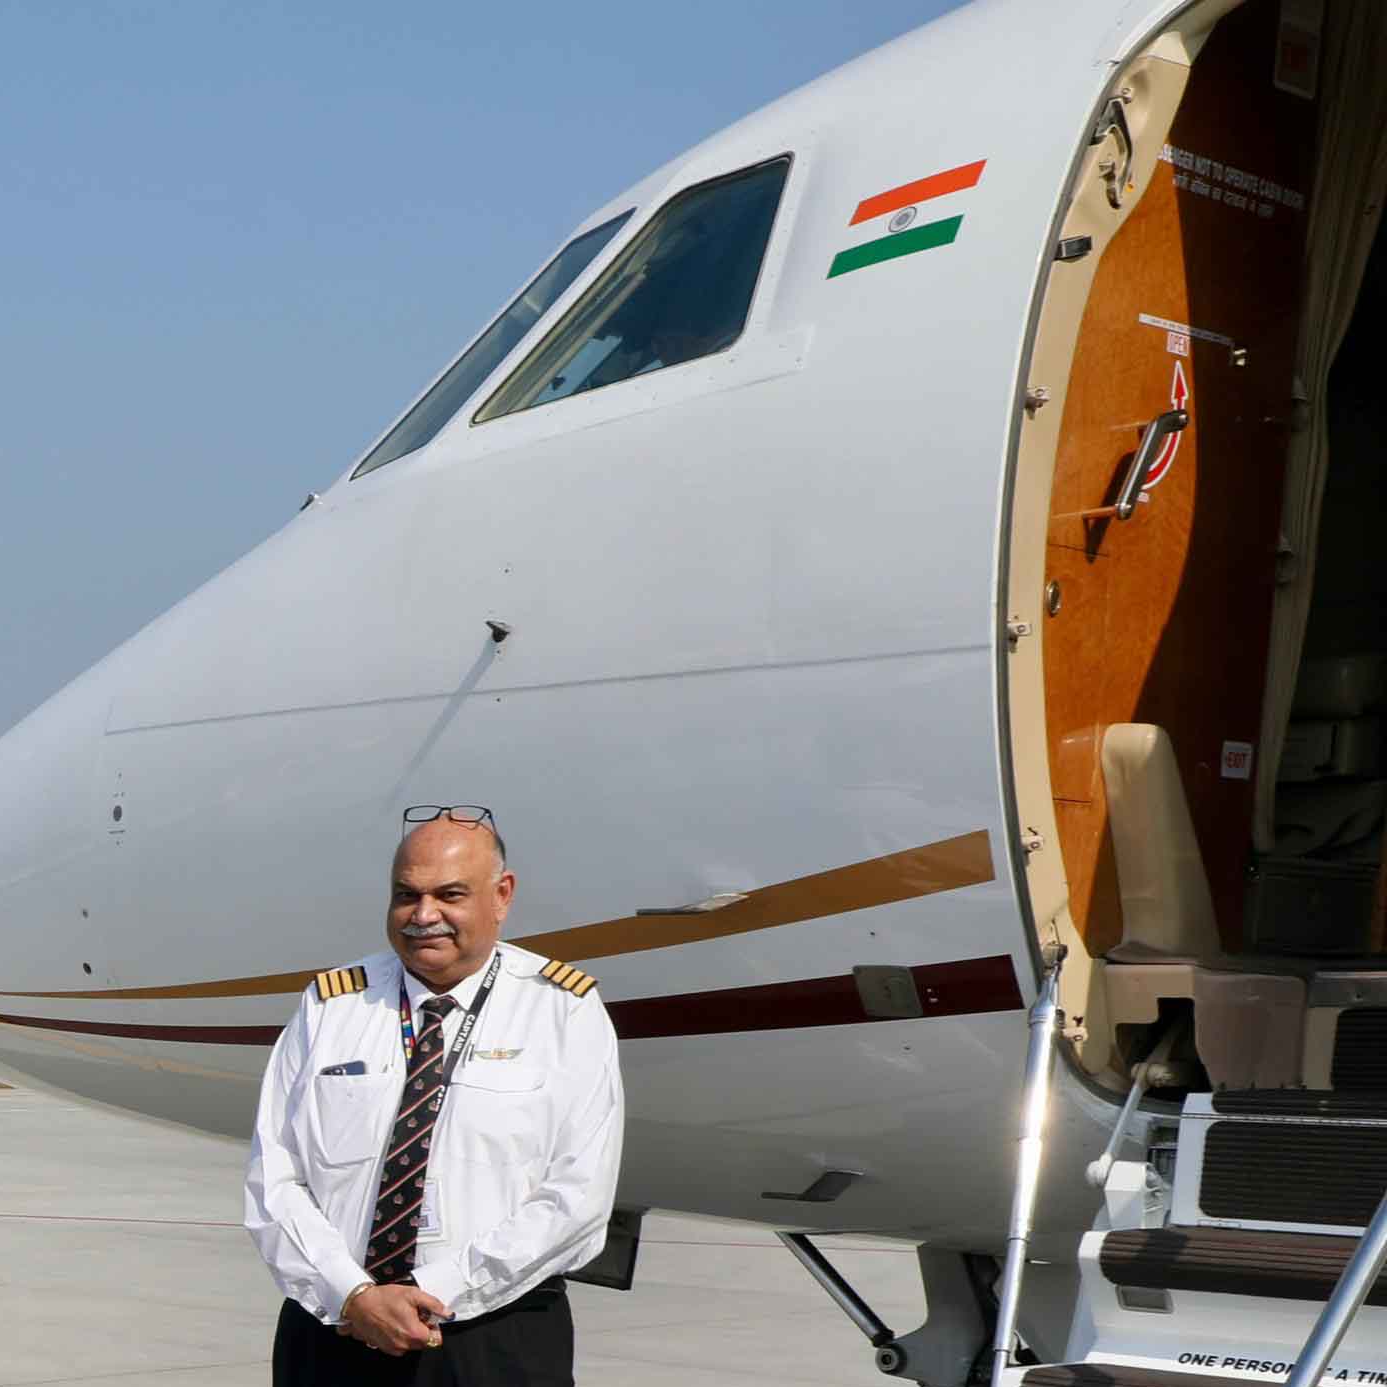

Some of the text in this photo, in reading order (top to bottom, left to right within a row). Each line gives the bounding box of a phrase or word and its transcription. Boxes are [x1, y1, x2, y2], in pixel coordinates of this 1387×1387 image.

[452, 1014, 476, 1053] CAPTAIN
[1178, 1352, 1219, 1368] ONE
[1335, 1368, 1348, 1381] A
